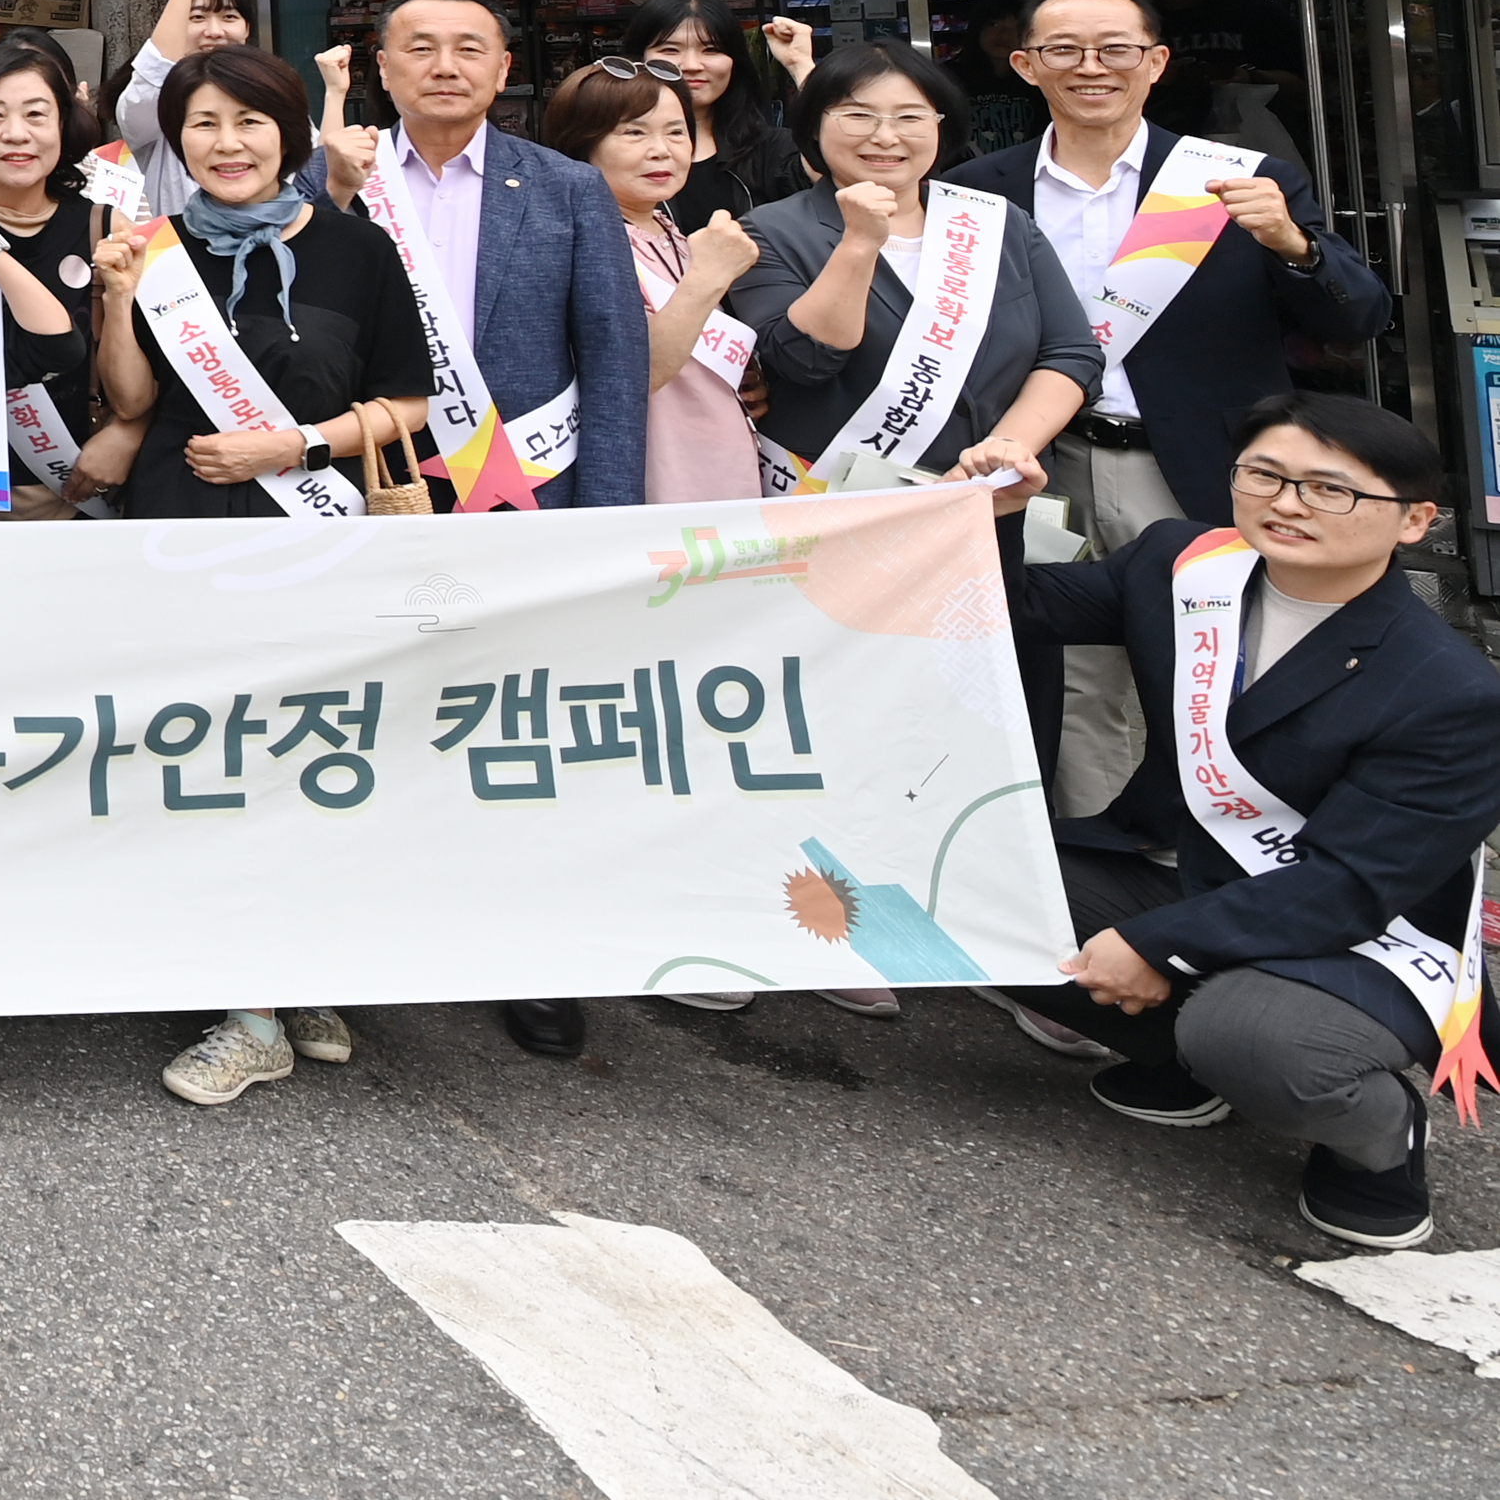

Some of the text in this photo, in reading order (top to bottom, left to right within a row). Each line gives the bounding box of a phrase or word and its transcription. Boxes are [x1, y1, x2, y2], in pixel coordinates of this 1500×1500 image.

[937, 186, 998, 208] Yeonsu
[149, 287, 201, 318] Yeonsu
[923, 211, 982, 352] 소방통로확보
[860, 353, 943, 460] 동참합시
[1180, 594, 1233, 615] Yeonsu
[431, 656, 827, 801] 캠페인
[1187, 626, 1264, 822] 지역물가안정
